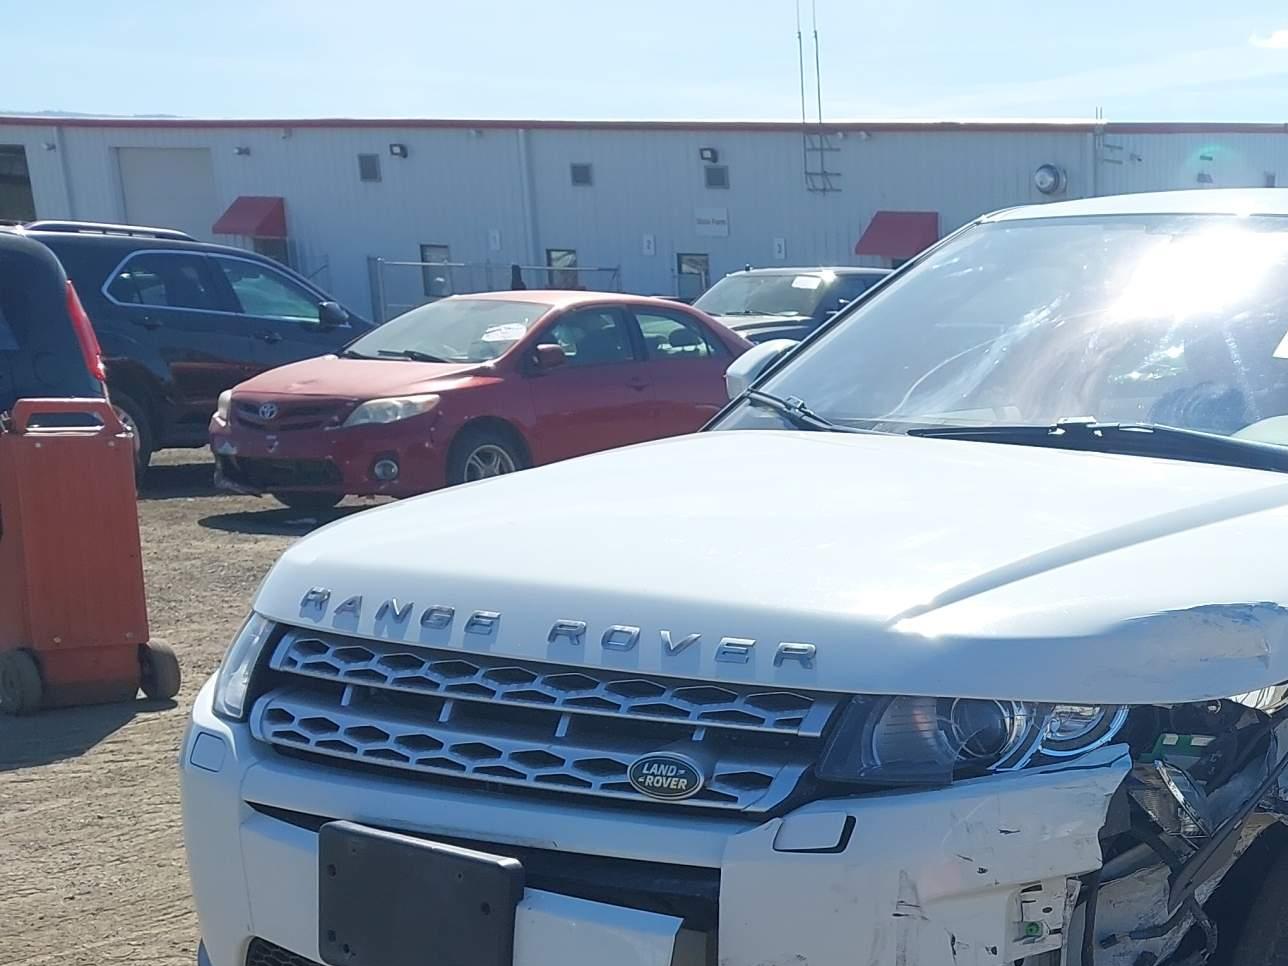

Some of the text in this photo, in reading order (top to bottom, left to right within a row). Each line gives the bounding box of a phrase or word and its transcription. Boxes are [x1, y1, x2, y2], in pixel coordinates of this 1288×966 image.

[300, 585, 817, 668] RANGE ROVER
[642, 762, 677, 777] LAND
[644, 775, 688, 790] ROVER
